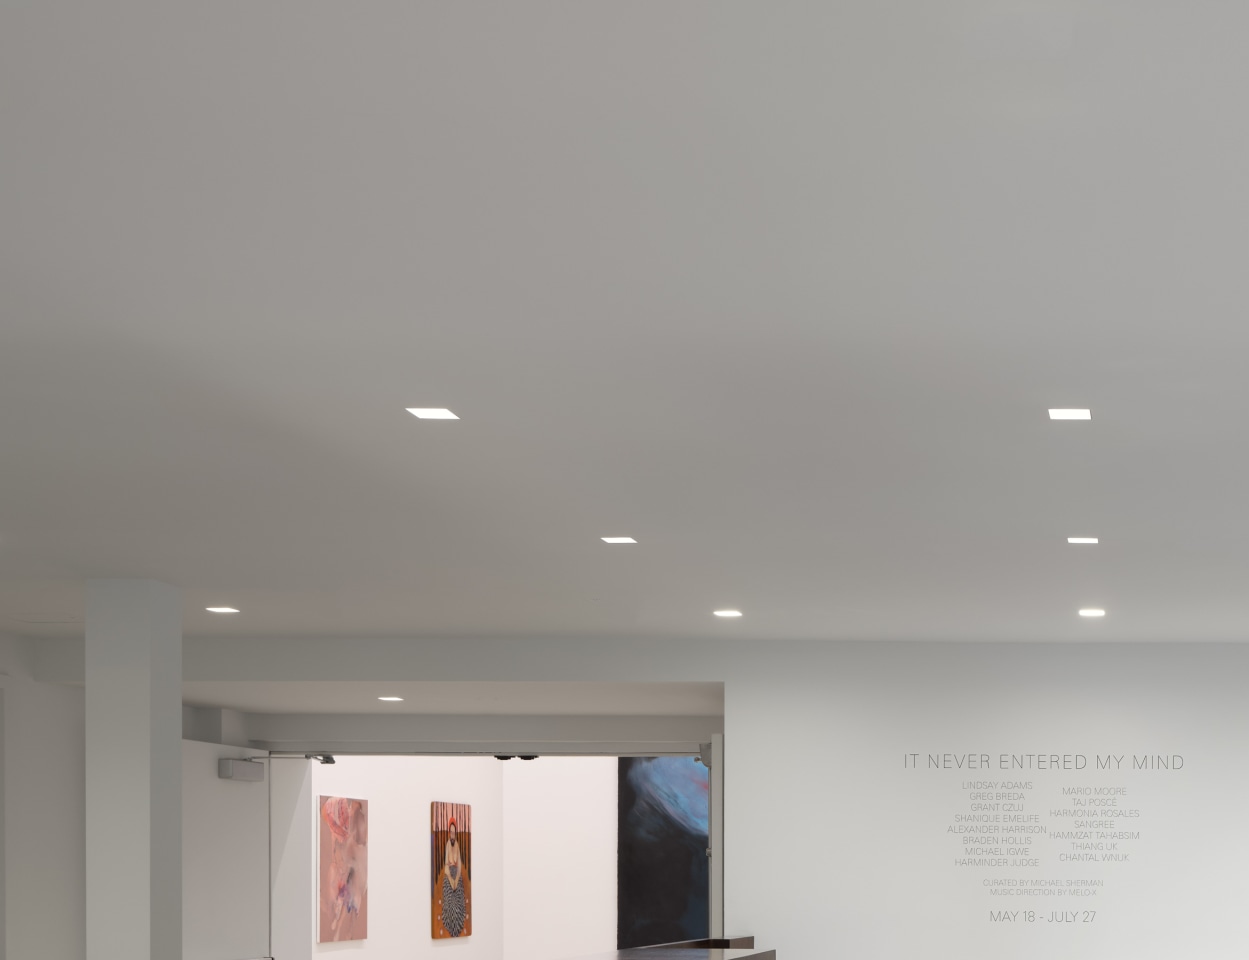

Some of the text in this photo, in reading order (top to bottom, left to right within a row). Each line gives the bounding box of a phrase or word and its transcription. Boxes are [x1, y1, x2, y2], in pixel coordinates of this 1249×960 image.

[904, 754, 1184, 769] IT NEVER ENTERED MY MIND
[962, 781, 1033, 790] LINDSAY ADAMS
[1062, 787, 1128, 796] MARIO MOORE
[969, 792, 1026, 801] GREG BREDA
[1072, 797, 1087, 807] TAJ
[970, 803, 1001, 812] GRANT
[1049, 809, 1140, 818] HARMONIA ROSALES
[954, 814, 1040, 823] SHANIQUE EMELIFE
[1074, 820, 1115, 829] SANGREE
[947, 825, 1047, 834] ALEXANDER HARRISON
[962, 836, 1033, 845] BRADEN HOLLIS
[1071, 842, 1118, 851] THIANG UK
[965, 847, 1030, 856] MICHAEL IGWE
[1059, 853, 1100, 862] CHANTAL
[954, 858, 1040, 867] HARMINDER JUDGE
[983, 879, 1104, 887] CURATED BY MICHAEL SHERMAN
[990, 888, 1015, 896] MUSIC
[1016, 888, 1056, 896] DIRECTION
[1057, 888, 1067, 896] BY
[990, 910, 1020, 923] MAY
[1023, 910, 1036, 923] 18
[1047, 910, 1079, 923] JULY
[1082, 910, 1097, 923] 27
